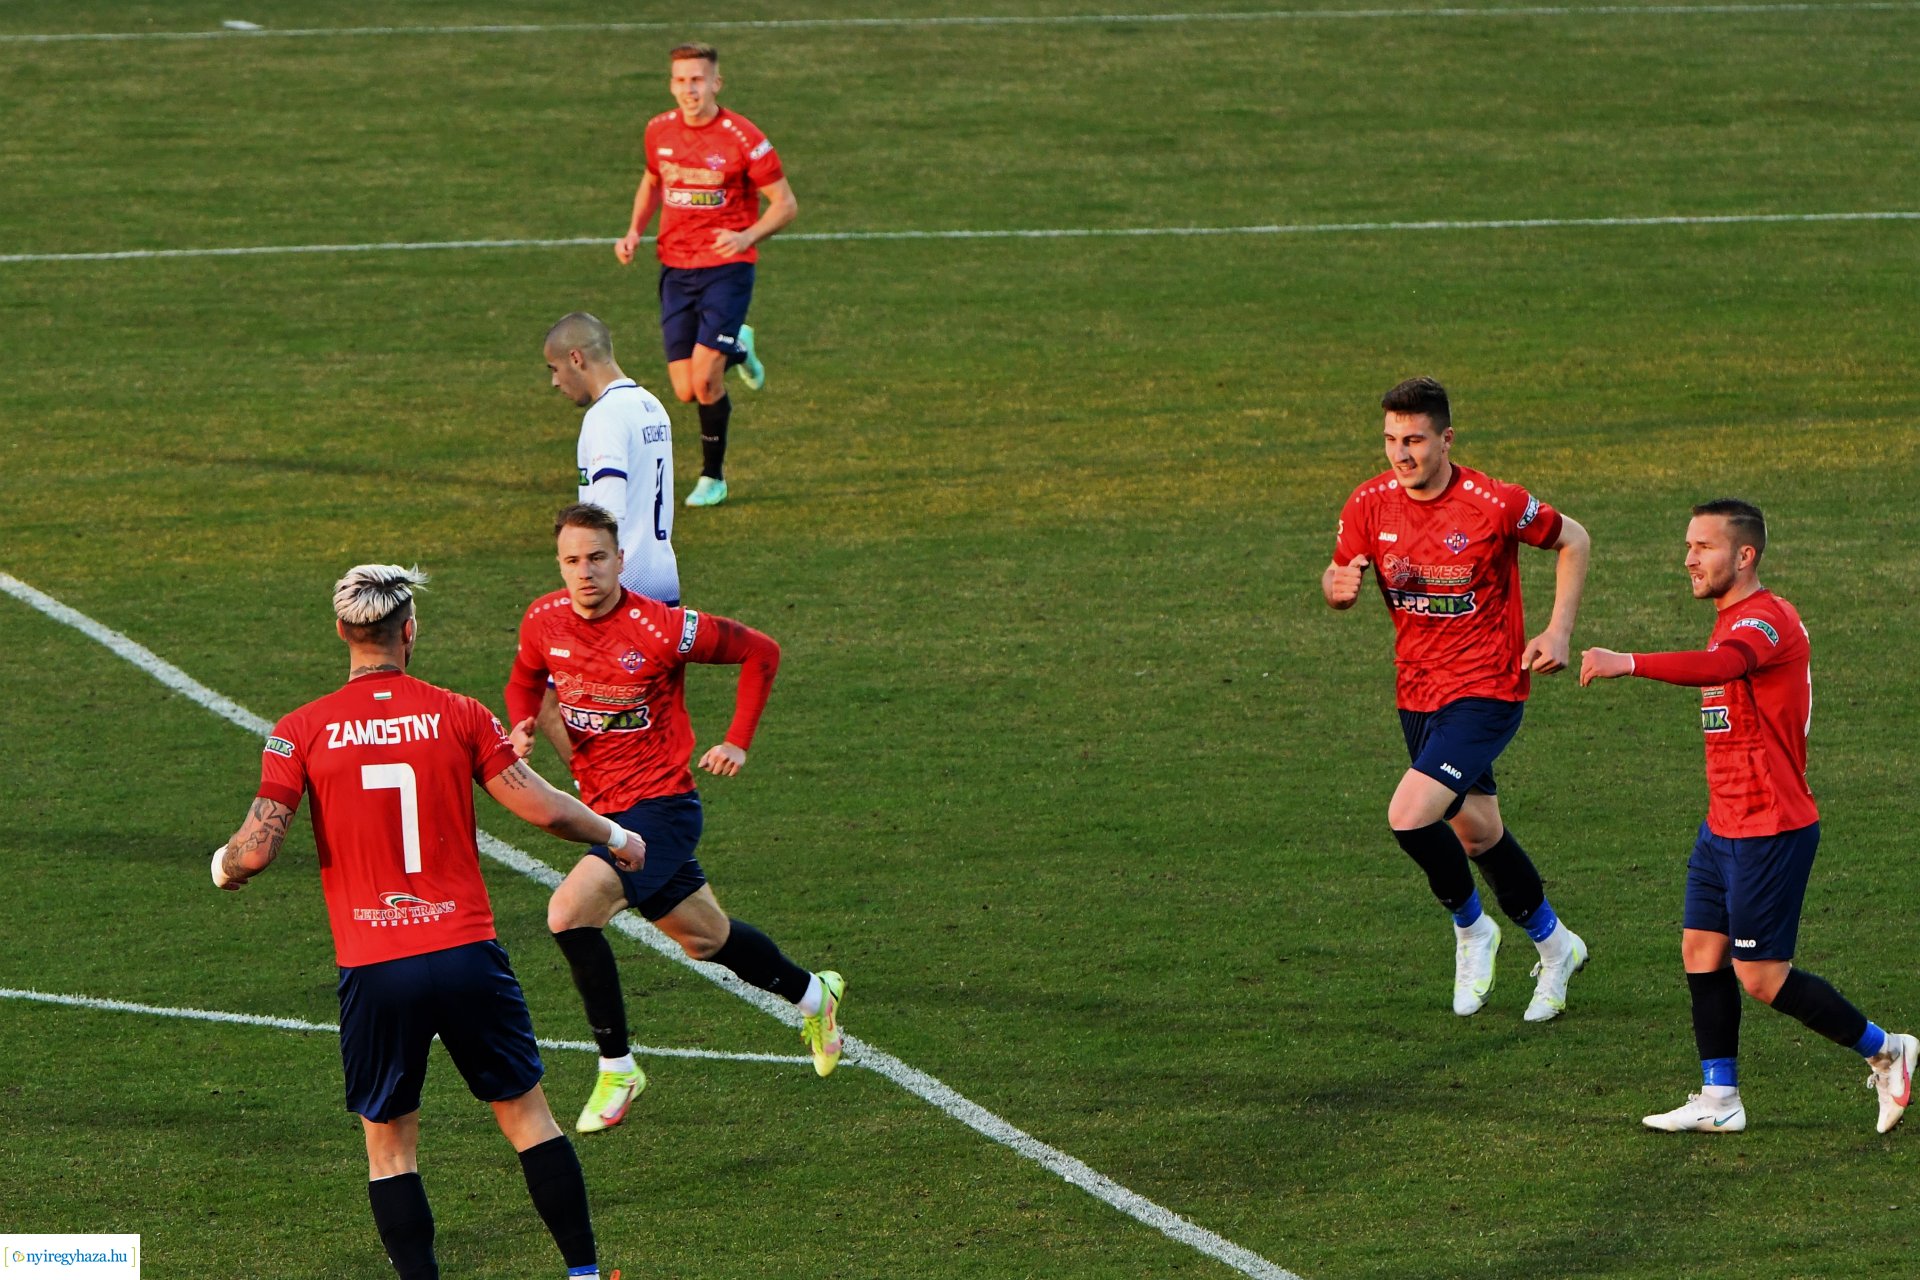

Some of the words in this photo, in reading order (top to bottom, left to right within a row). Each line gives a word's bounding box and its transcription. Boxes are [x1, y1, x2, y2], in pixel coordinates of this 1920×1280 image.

[325, 713, 441, 749] ZAMOSTNY
[1440, 762, 1462, 779] JAKO
[361, 763, 422, 874] 7
[409, 901, 456, 917] TRANS
